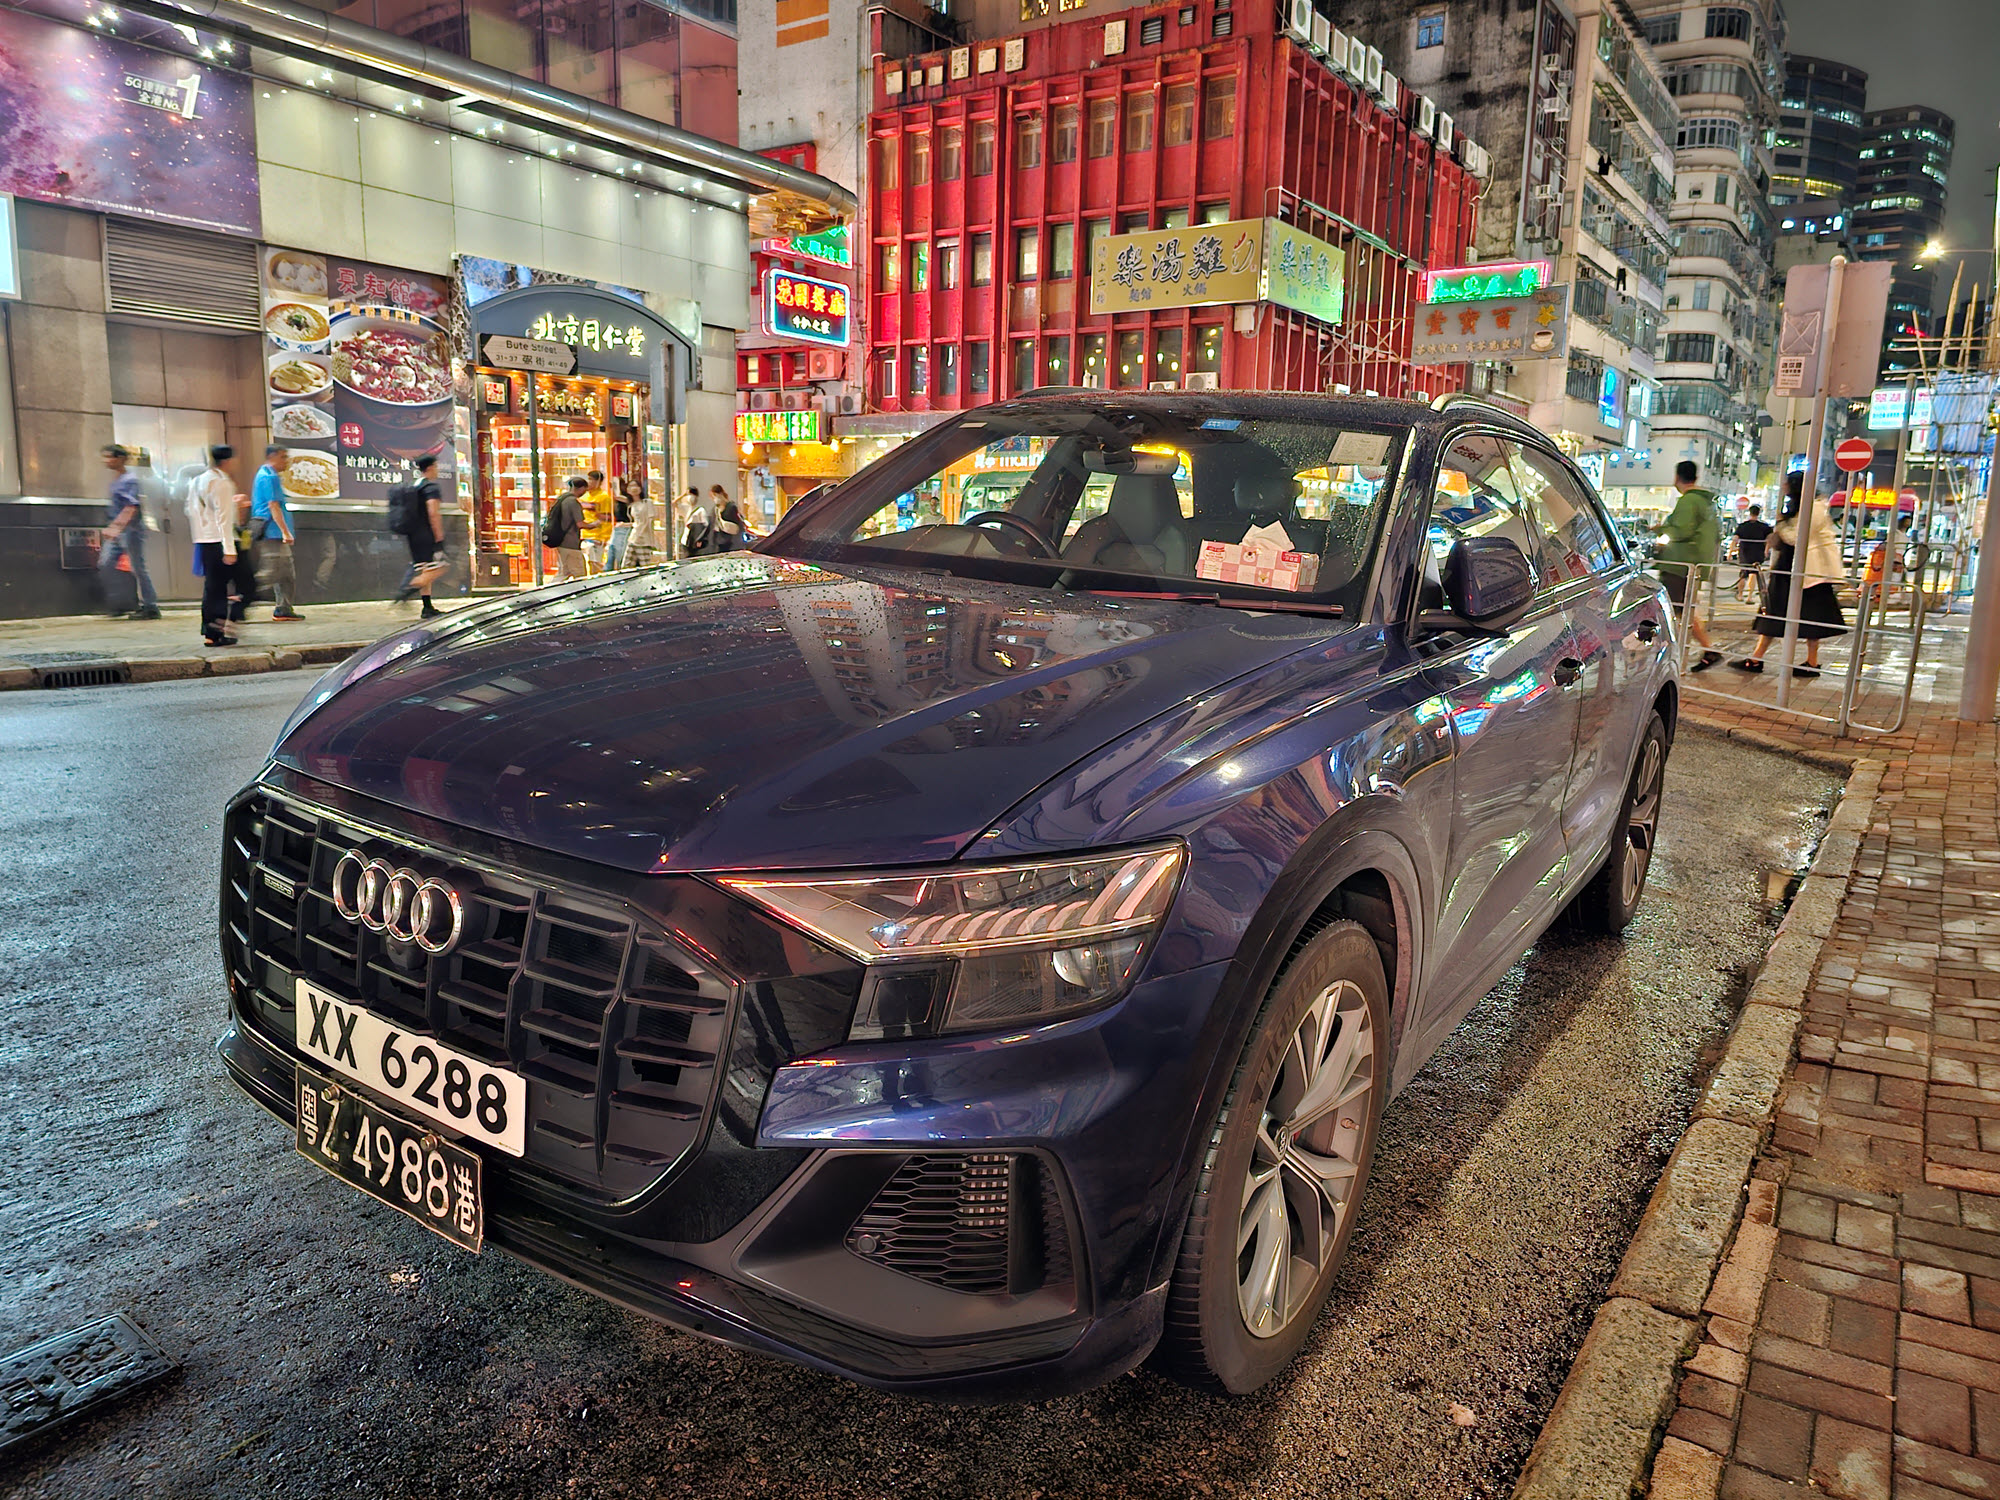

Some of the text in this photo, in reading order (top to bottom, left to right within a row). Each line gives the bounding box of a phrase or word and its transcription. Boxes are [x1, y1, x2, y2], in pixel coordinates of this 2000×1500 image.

[336, 267, 412, 304] 夏麵館
[532, 312, 646, 357] 北京同仁堂
[506, 339, 559, 356] Bute Street
[495, 354, 518, 363] 31-37
[548, 361, 568, 369] 41-49
[343, 425, 360, 435] 上海
[343, 436, 361, 446] 味道
[308, 992, 508, 1135] XX 6288
